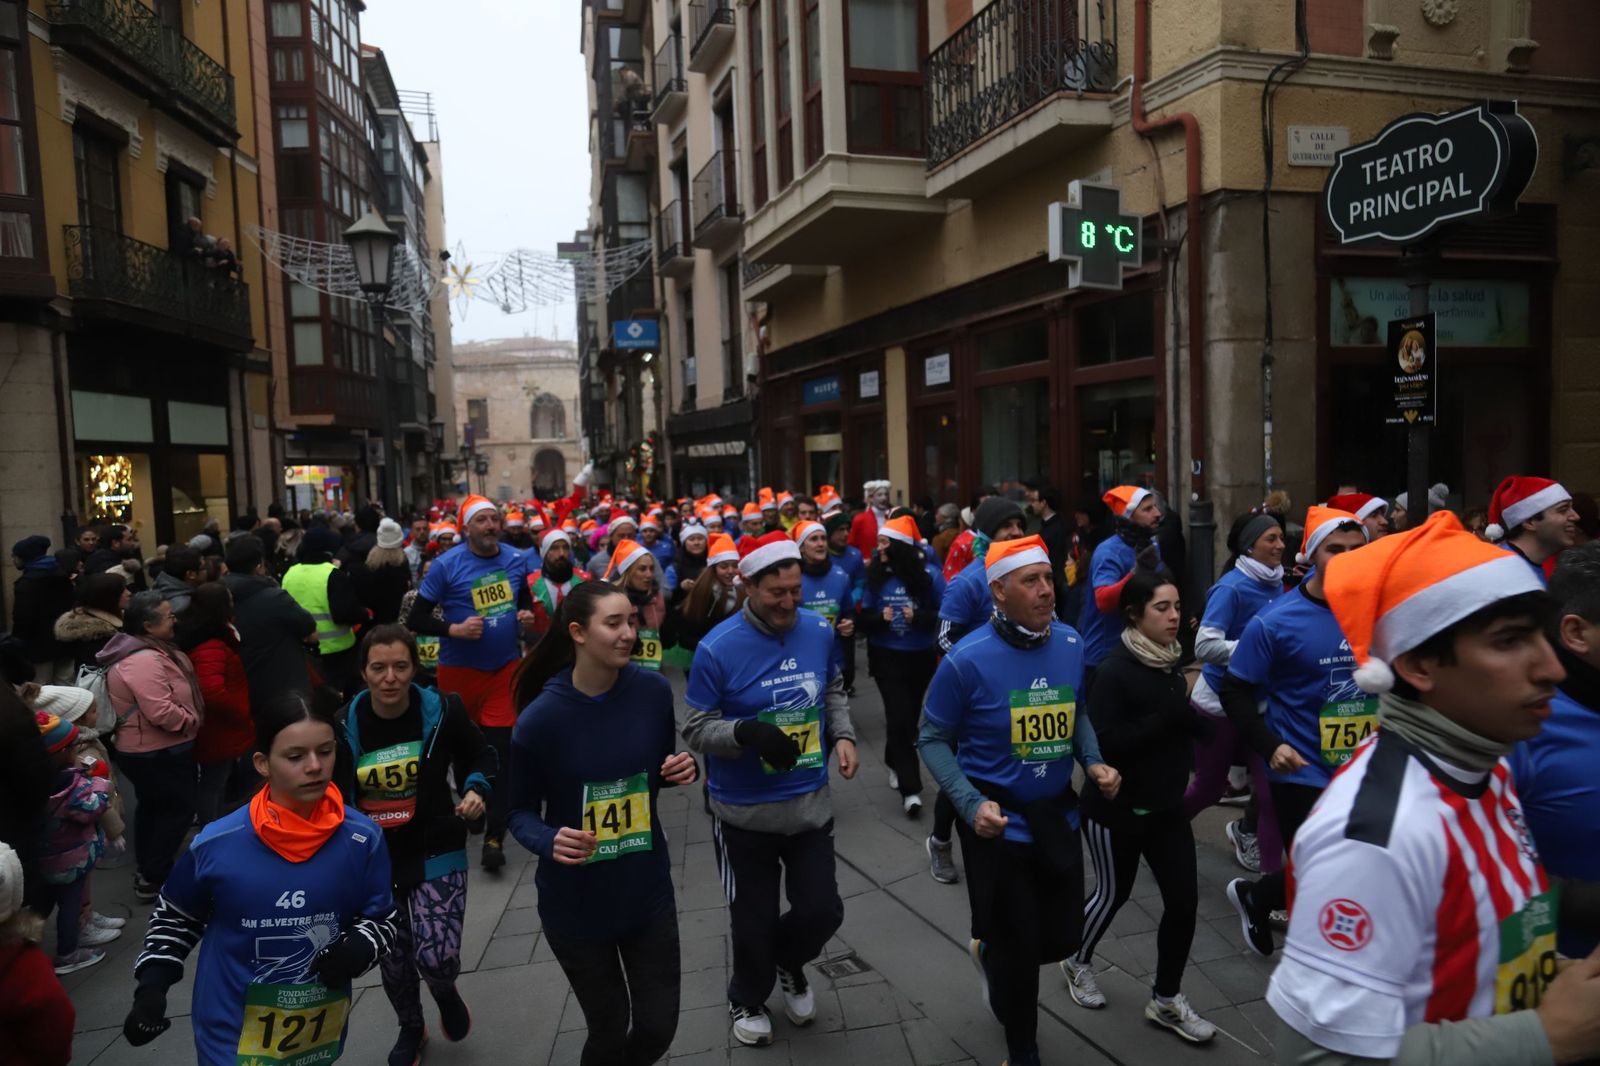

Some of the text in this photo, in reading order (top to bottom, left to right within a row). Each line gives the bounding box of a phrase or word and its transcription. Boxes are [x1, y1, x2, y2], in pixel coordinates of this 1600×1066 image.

[1310, 132, 1336, 141] CALLE
[1314, 142, 1326, 151] DE
[1361, 137, 1454, 186] TEATRO
[1349, 172, 1472, 225] PRINCIPAL
[1081, 220, 1096, 249] 8
[1369, 287, 1385, 302] Un
[1386, 287, 1408, 302] aliad
[1437, 287, 1449, 302] la
[1451, 287, 1486, 302] salud
[477, 584, 506, 605] 1188
[1339, 639, 1353, 651] 4
[779, 658, 797, 671] 46
[761, 680, 773, 688] SAN
[774, 673, 803, 685] SILVESTRE
[1030, 677, 1048, 689] 46
[1016, 711, 1068, 742] 1308
[1325, 721, 1371, 749] 754
[1033, 746, 1052, 754] CAJA
[365, 761, 419, 788] 459
[584, 799, 631, 836] 141
[619, 837, 648, 850] RURAL
[275, 890, 306, 910] 46
[241, 918, 257, 929] SAN
[260, 914, 314, 929] SILVESTRE
[277, 986, 328, 998] FUNDACIÓN
[277, 993, 327, 1005] CAJA RURAL
[258, 1008, 328, 1053] 121
[295, 1049, 332, 1066] RURAL
